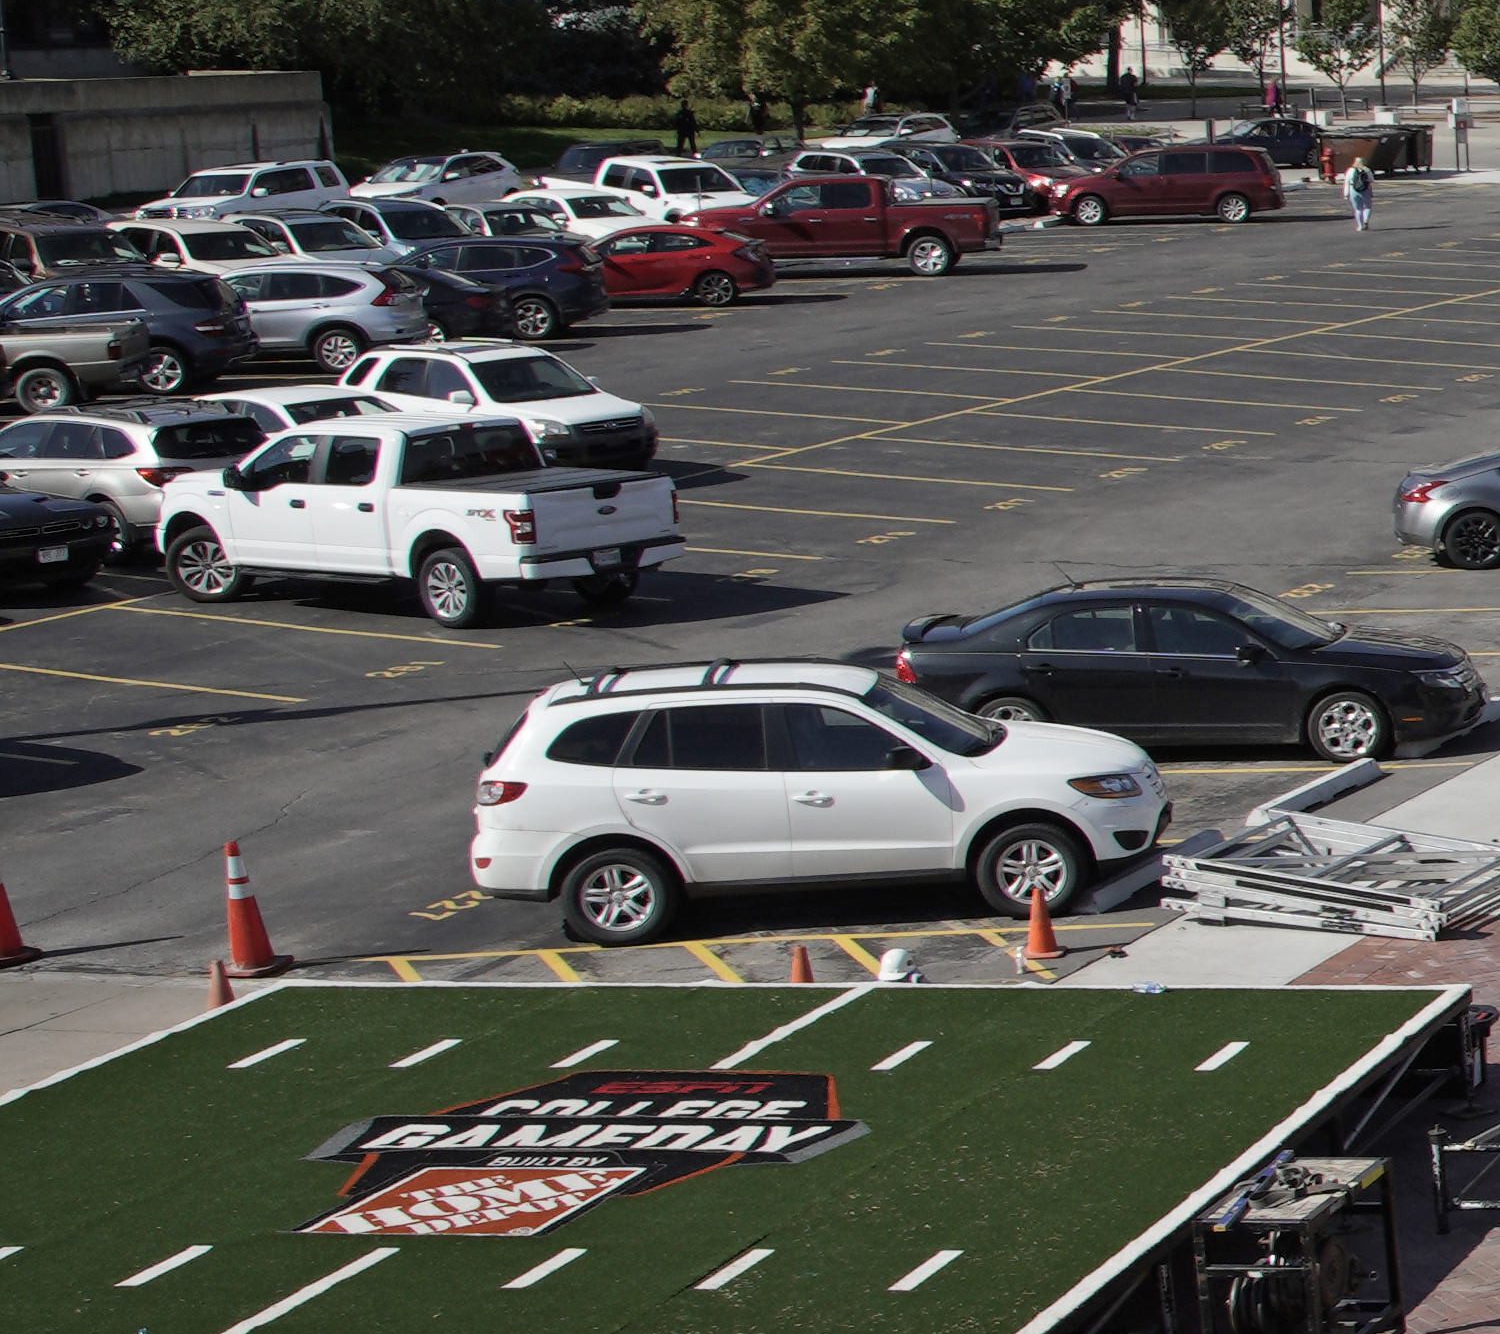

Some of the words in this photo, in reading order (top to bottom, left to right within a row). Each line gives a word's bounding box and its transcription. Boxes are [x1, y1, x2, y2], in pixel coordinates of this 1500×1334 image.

[589, 1081, 775, 1095] ESPN
[479, 1098, 808, 1120] COLLEGE
[358, 1123, 833, 1153] GAMEDAY
[492, 1155, 571, 1167] BUILT
[574, 1155, 608, 1168] BY
[334, 1168, 630, 1233] HOME
[399, 1173, 514, 1202] THE
[405, 1189, 604, 1236] DEPOT
